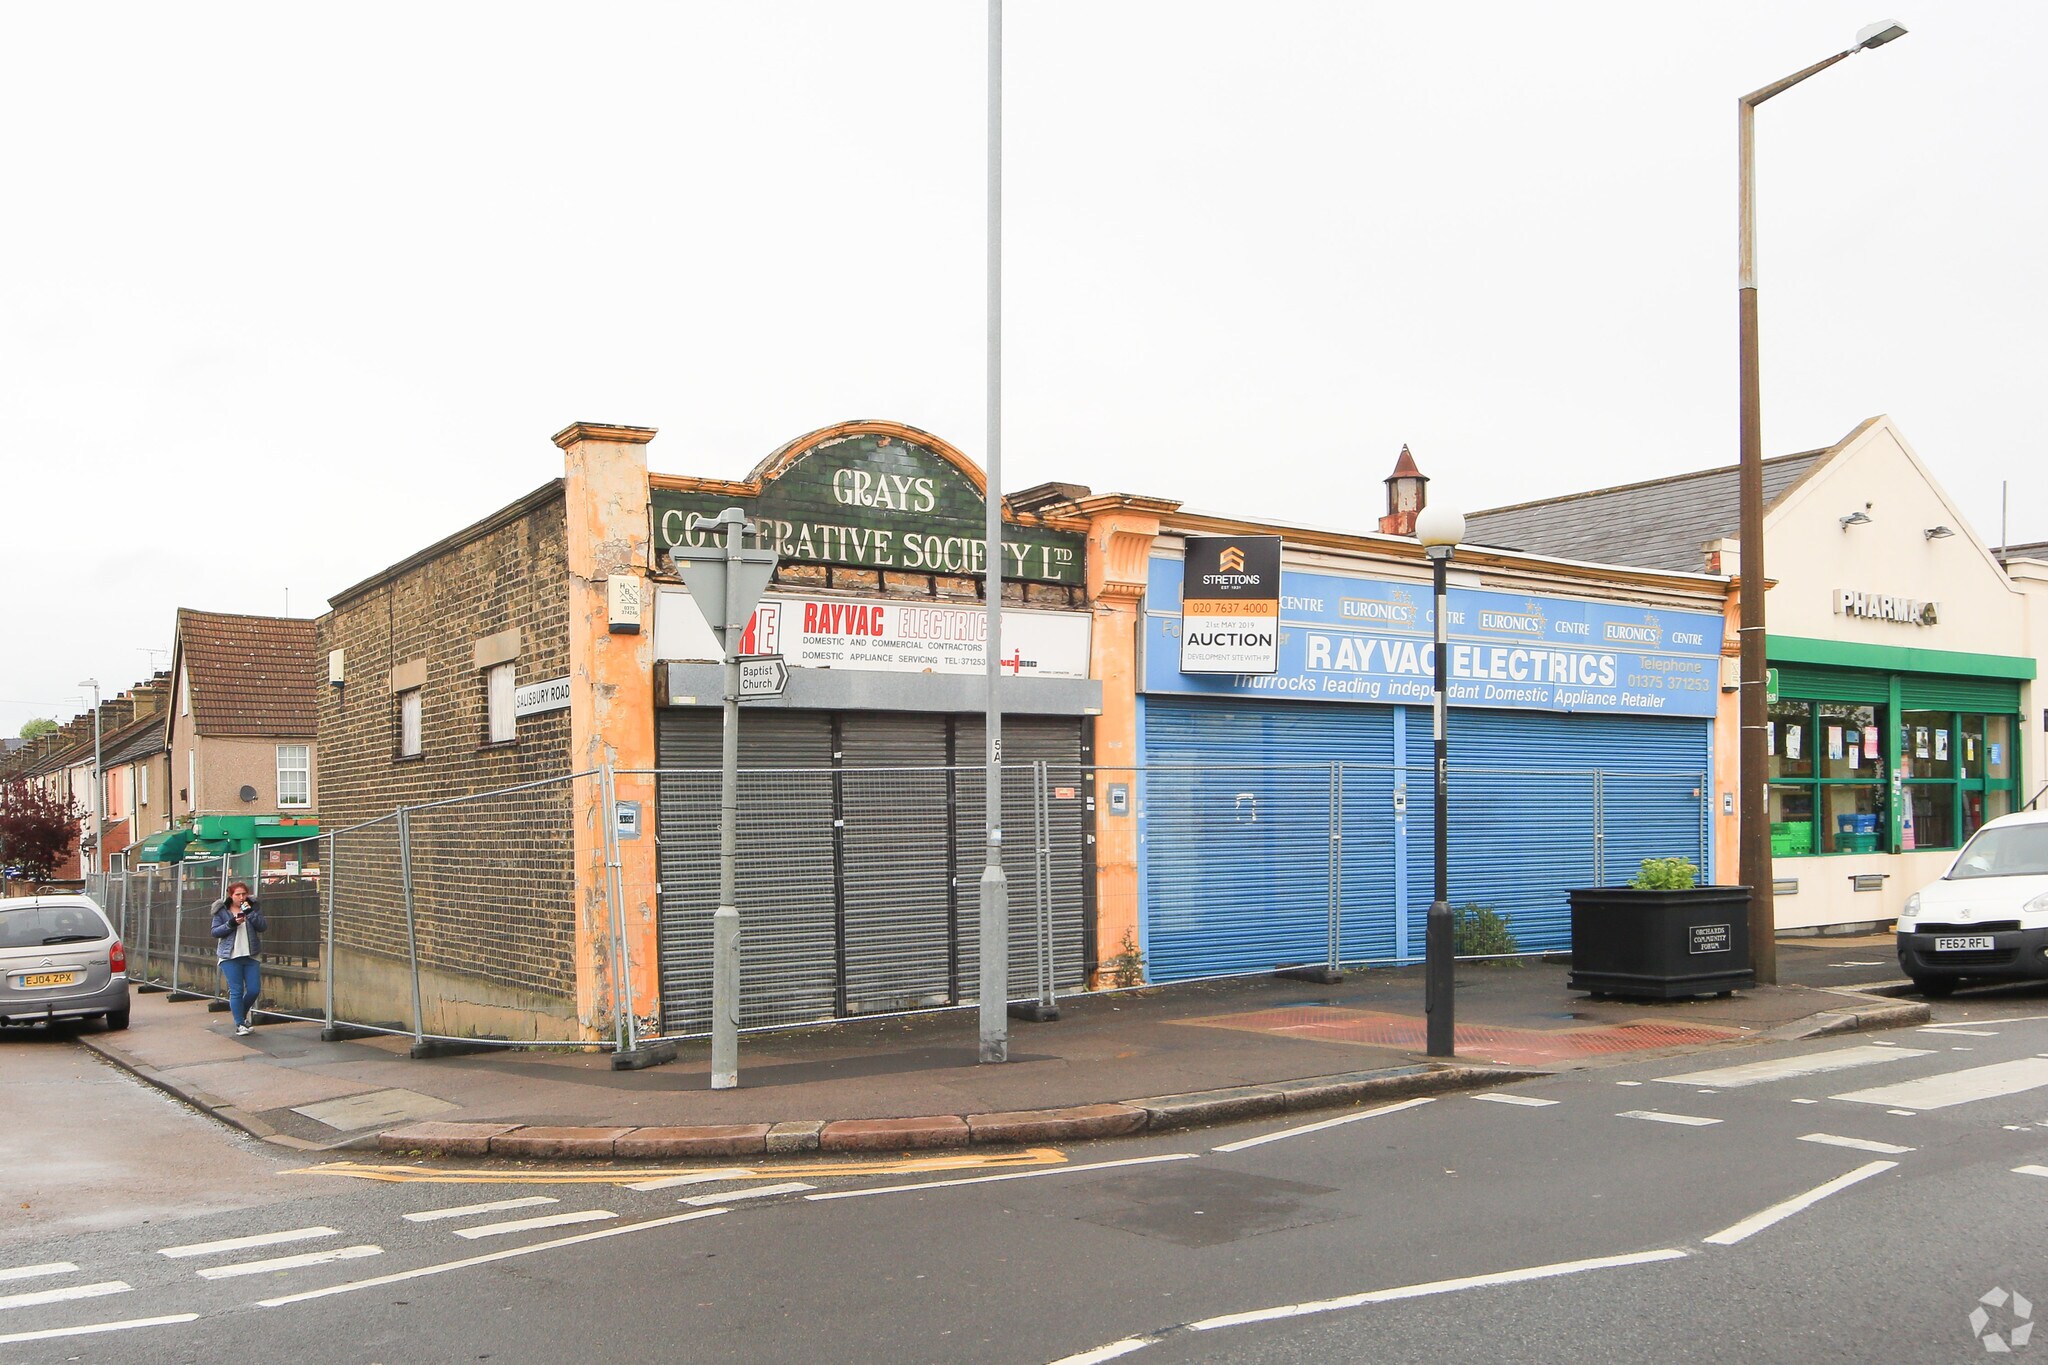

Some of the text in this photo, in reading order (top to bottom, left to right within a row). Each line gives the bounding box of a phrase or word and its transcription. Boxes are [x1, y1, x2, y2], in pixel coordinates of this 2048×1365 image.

[832, 468, 935, 512] GRAYS
[661, 509, 893, 565] COERATIVE
[903, 533, 1032, 577] SOCIEY
[1203, 574, 1260, 585] STRETTONS
[1193, 603, 1268, 613] 020 7637 4000
[804, 602, 1003, 642] RAYVAC ELECTRIC
[1221, 621, 1237, 629] MAY
[1279, 596, 1703, 646] CENTRE EURONICS CTRE EURONICS CENTRE EURONICS CENTRE
[802, 637, 983, 652] DOMESTIC AND COMMERCIAL CONTRACTORS
[1187, 633, 1272, 647] AUCTION
[802, 651, 844, 660] DOMESTIC
[849, 653, 893, 662] APPLIANCE
[898, 655, 938, 664] SERVICING
[1187, 653, 1230, 661] DEVELOPMENT
[743, 665, 773, 677] Baptist
[1453, 645, 1616, 686] ELECTRICS
[1639, 656, 1702, 673] Telephone
[742, 678, 773, 689] Church
[1628, 674, 1711, 691] 01375 371253
[516, 684, 570, 708] SALISBURY ROAD
[1233, 674, 1666, 708] Thurrocks leading indepdant Domestic Appliance Retailer
[1695, 927, 1725, 935] ORCHARDS
[1693, 935, 1727, 943] COMMUNITY
[1939, 938, 1990, 949] FE62 RFL
[26, 973, 72, 985] EJ04 ZPX
